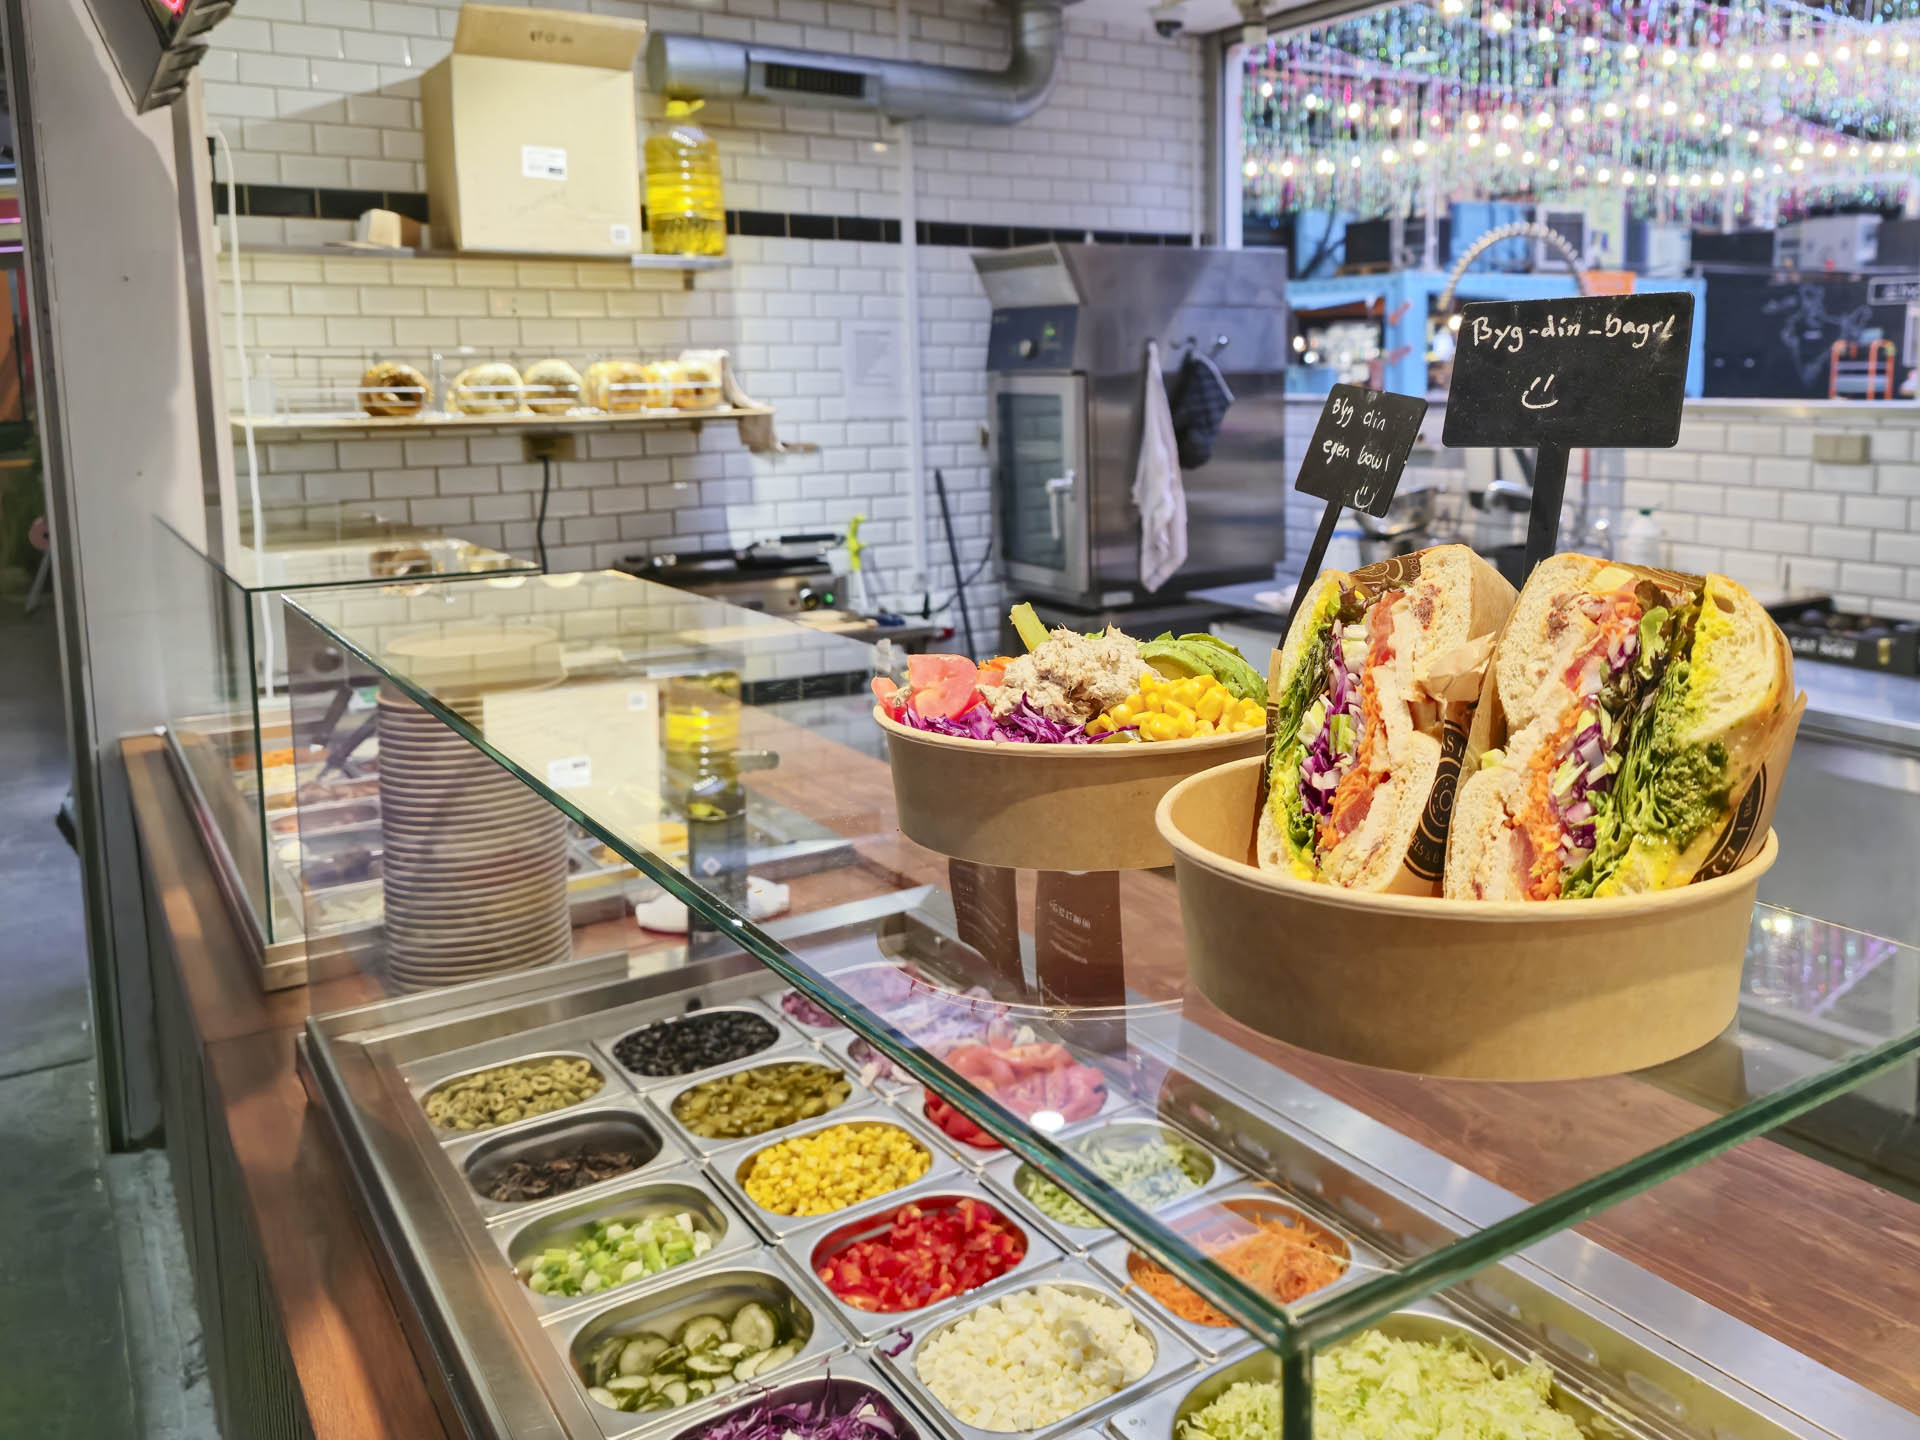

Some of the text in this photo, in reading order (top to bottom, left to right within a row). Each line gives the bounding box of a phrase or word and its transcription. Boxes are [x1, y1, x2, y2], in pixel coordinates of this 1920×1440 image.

[1332, 398, 1386, 431] Byg din
[1323, 440, 1391, 472] egen bowl
